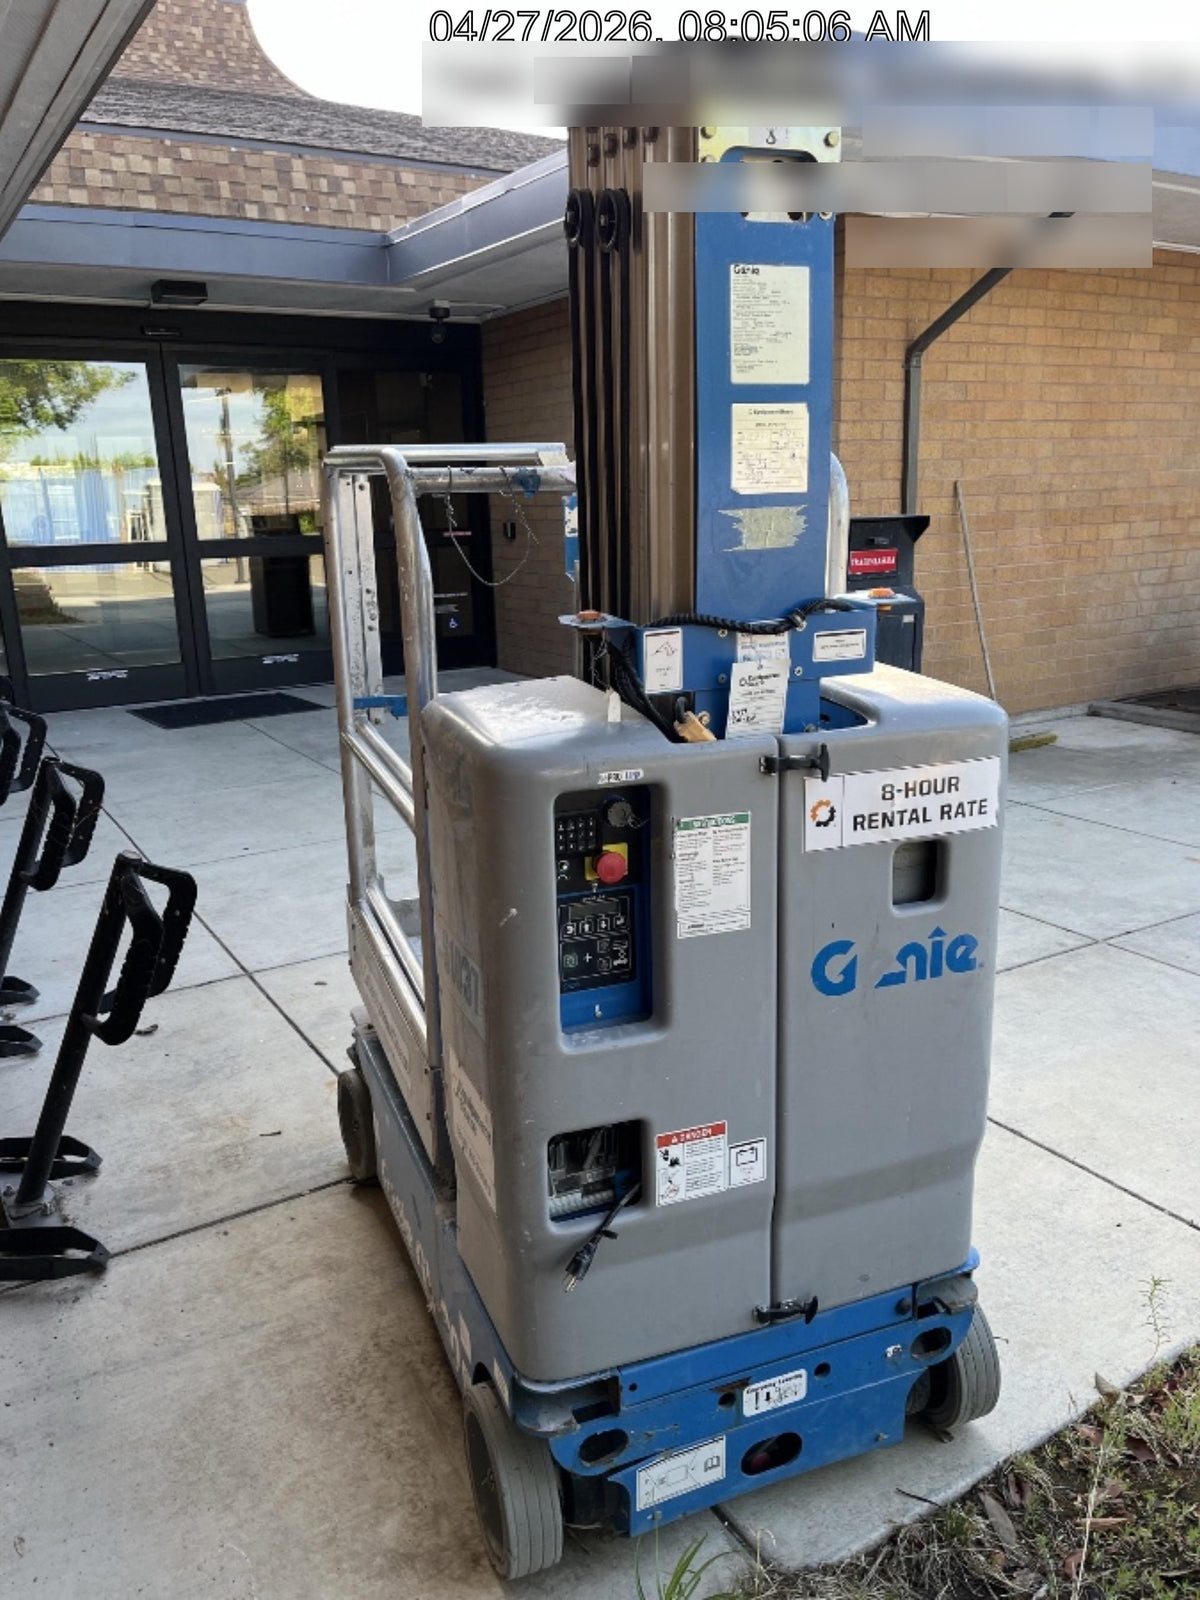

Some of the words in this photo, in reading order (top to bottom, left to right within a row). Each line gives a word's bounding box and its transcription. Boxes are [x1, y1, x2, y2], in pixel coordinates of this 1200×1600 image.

[881, 776, 960, 802] 8-HOUR
[853, 809, 932, 832] RENTAL
[940, 798, 988, 821] RATE
[811, 926, 979, 996] Gnie
